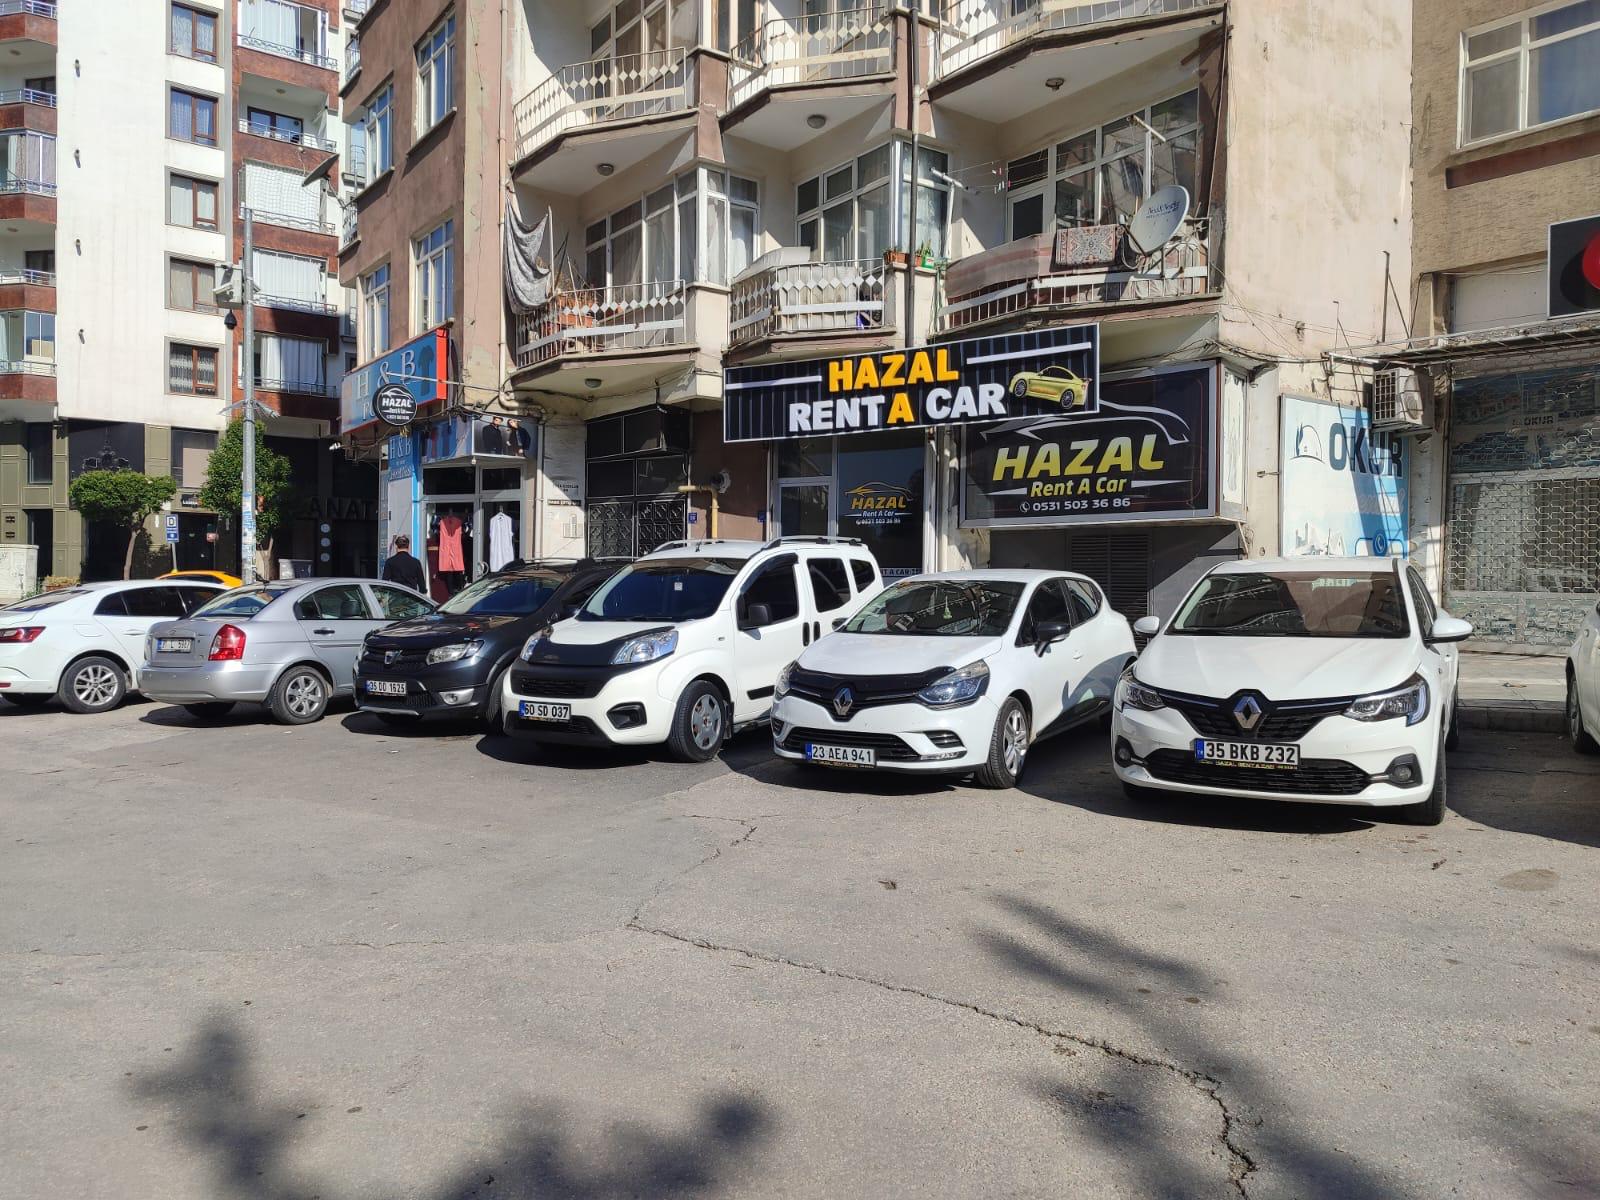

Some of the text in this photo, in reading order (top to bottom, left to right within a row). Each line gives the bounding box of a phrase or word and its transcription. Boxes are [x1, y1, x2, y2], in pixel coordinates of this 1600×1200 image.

[400, 350, 416, 384] B
[828, 349, 960, 392] HAZAL
[382, 398, 412, 407] HAZAL
[788, 382, 1007, 432] RENT A CAR
[992, 433, 1165, 481] HAZAL
[1329, 422, 1403, 477] OKUR
[1030, 476, 1128, 497] Rent A Car
[851, 496, 906, 510] HAZAL
[1033, 497, 1131, 511] 0531 503 36 86
[370, 681, 378, 691] 35
[551, 706, 569, 718] 037
[812, 745, 825, 758] 23
[828, 747, 849, 760] AEA
[851, 749, 871, 763] 941
[1206, 742, 1295, 763] 35 BKB 232
